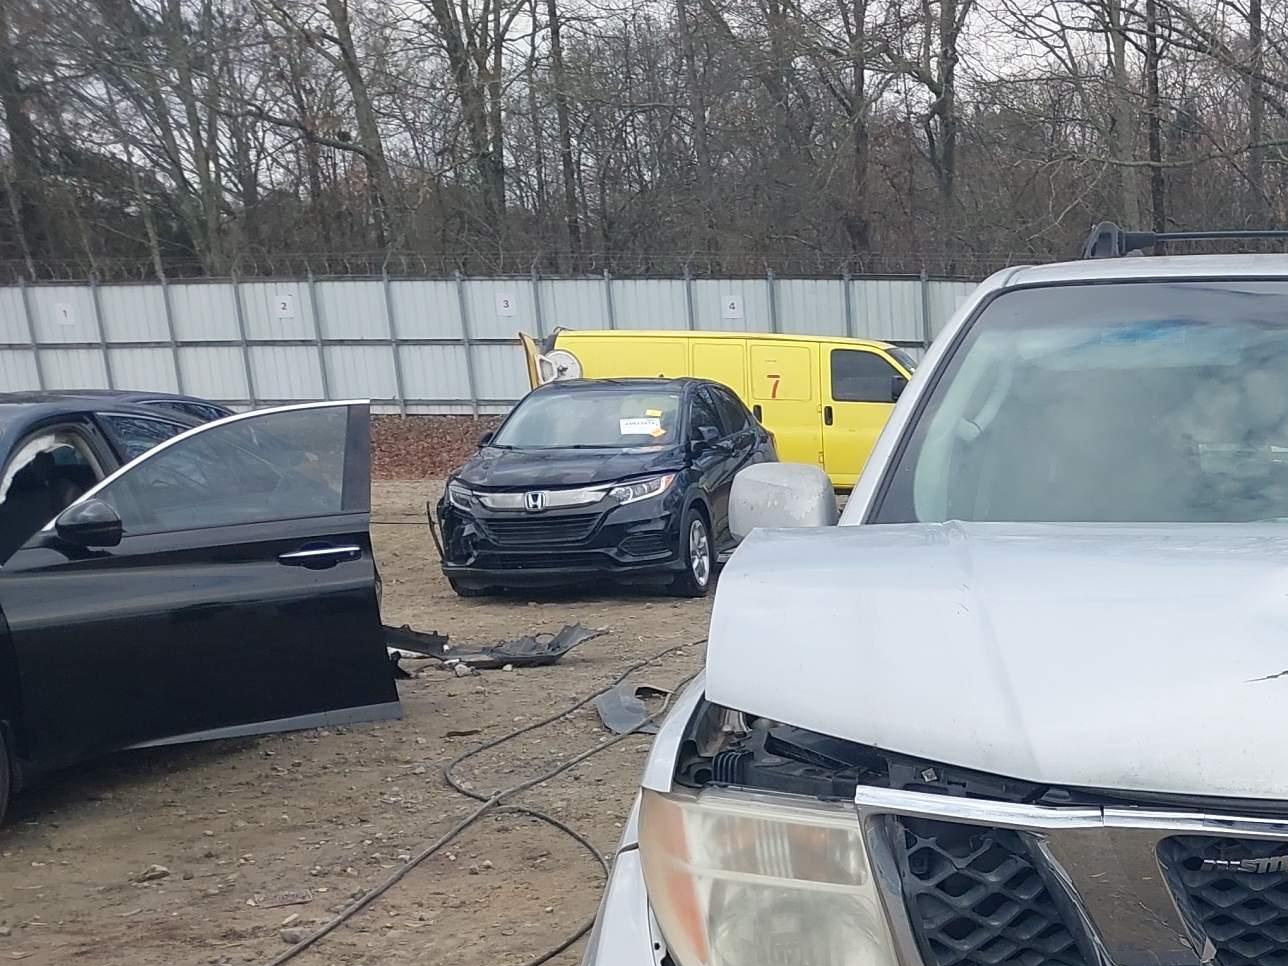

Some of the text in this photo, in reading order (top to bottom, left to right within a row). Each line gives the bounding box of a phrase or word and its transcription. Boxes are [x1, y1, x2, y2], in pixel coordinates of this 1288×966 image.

[280, 302, 288, 311] 2
[503, 299, 510, 309] 3
[729, 301, 736, 310] 4
[766, 374, 781, 399] 7
